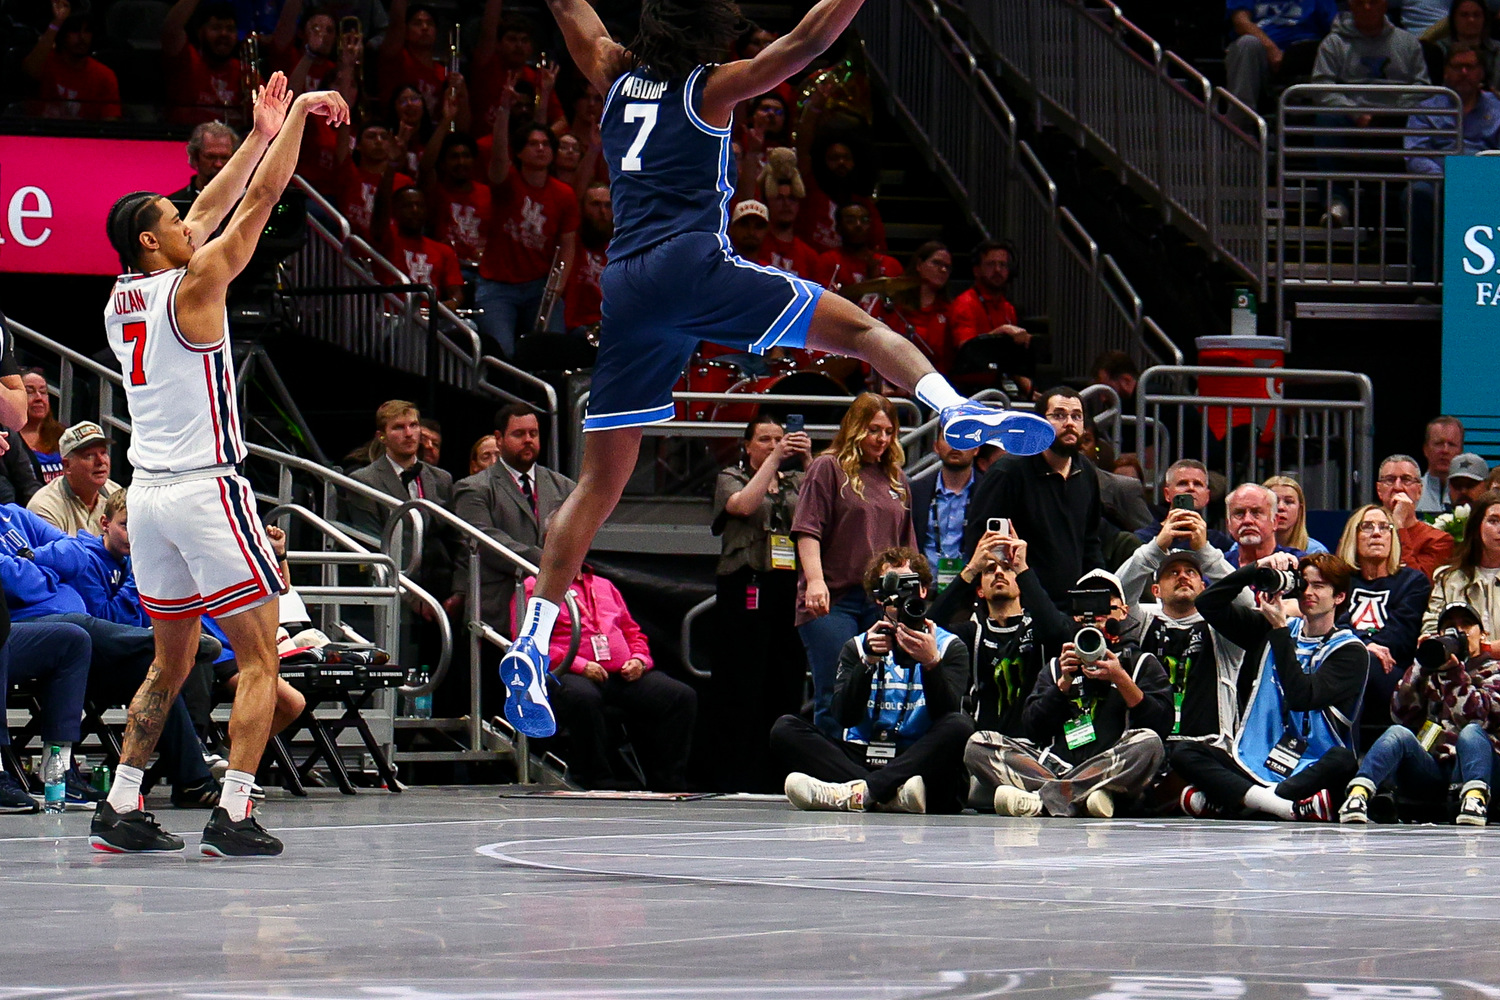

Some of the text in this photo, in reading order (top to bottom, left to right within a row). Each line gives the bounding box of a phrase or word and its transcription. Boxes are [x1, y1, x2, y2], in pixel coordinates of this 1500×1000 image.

[621, 103, 660, 172] 7
[113, 288, 147, 316] UZAN
[122, 320, 148, 387] 7
